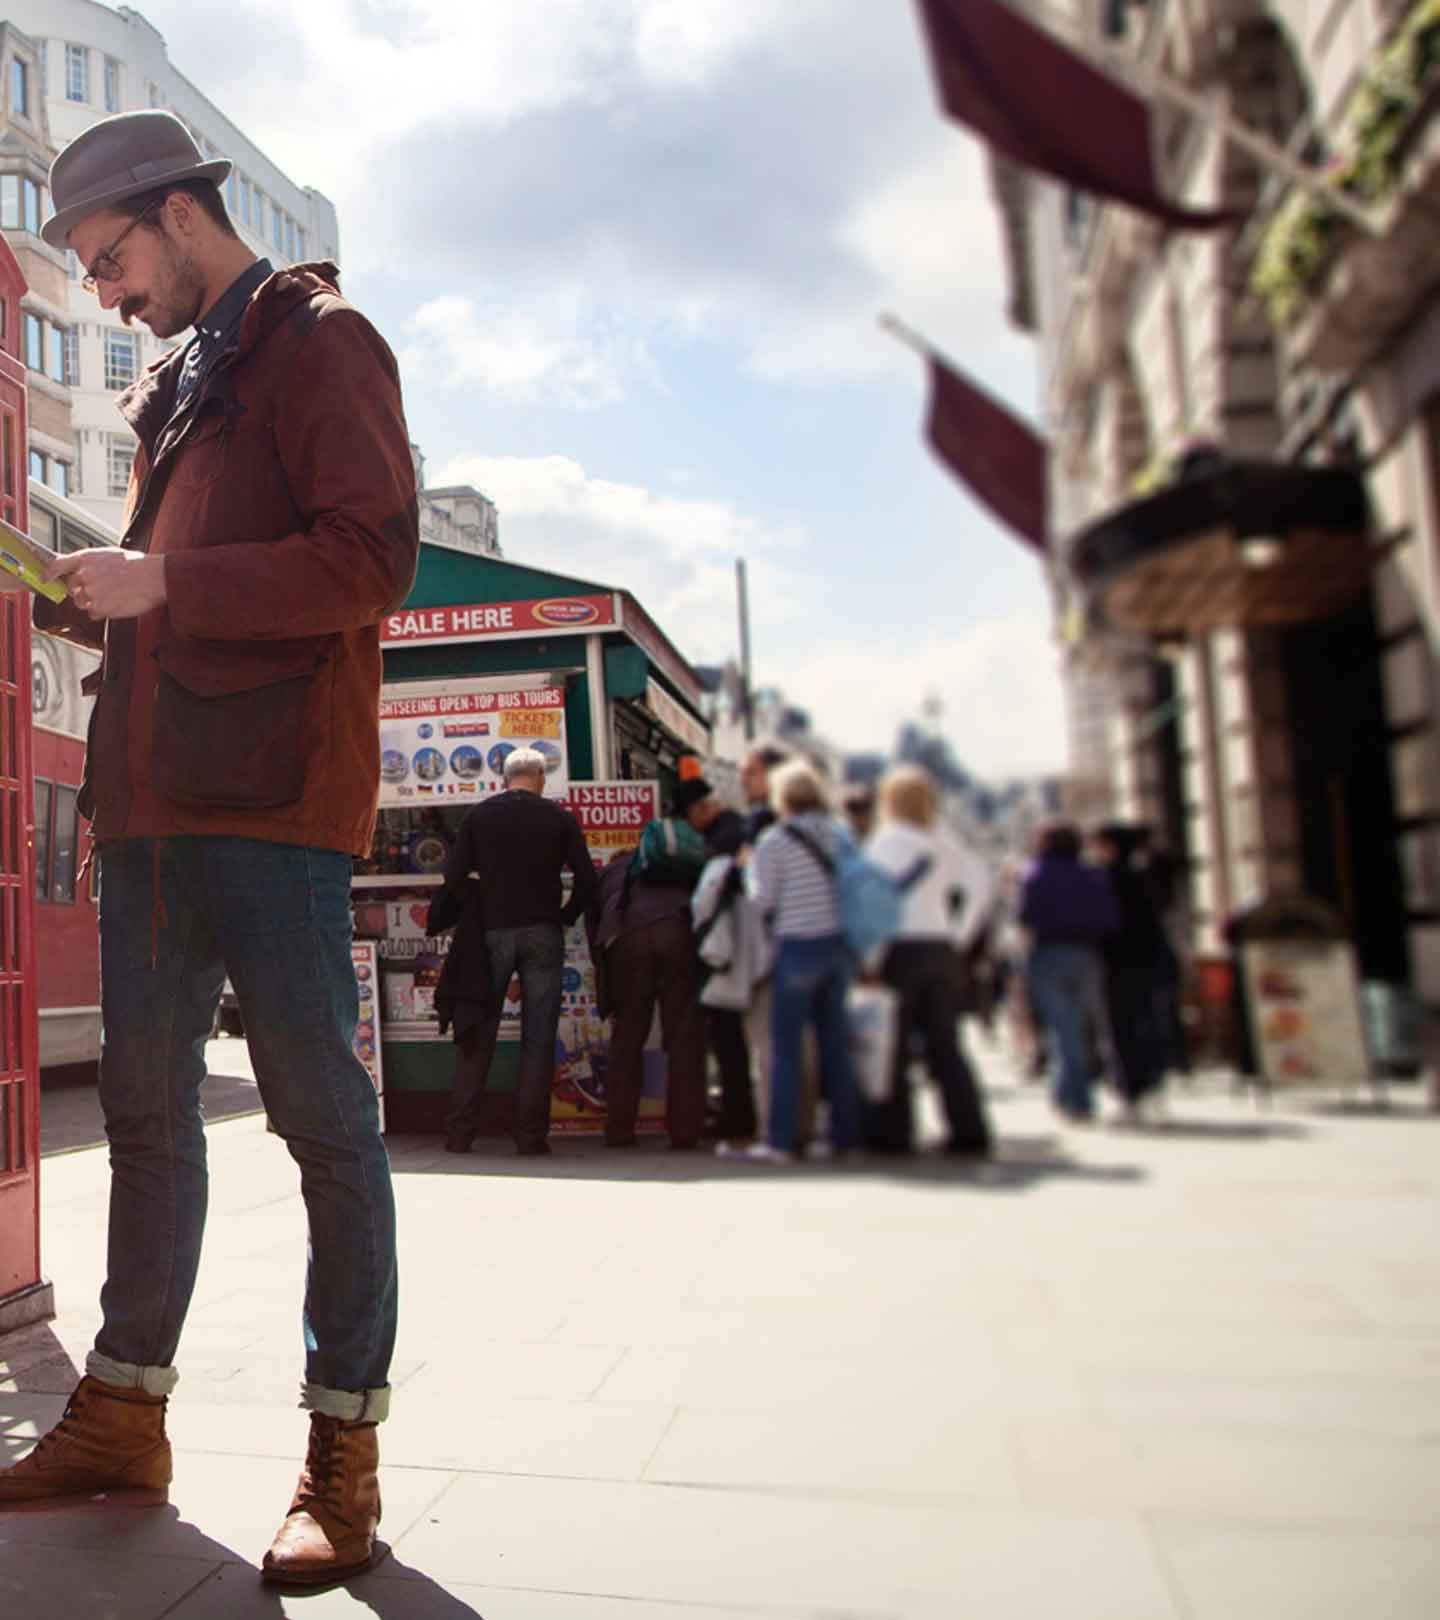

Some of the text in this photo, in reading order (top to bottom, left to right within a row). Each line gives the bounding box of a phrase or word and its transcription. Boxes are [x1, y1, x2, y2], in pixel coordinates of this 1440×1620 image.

[388, 612, 445, 636] SALE
[451, 607, 513, 632] HERE
[498, 692, 521, 708] BUS
[523, 689, 561, 706] TOURS
[504, 710, 555, 725] TICKETS
[512, 723, 545, 736] HERE
[579, 805, 642, 825] TOURS
